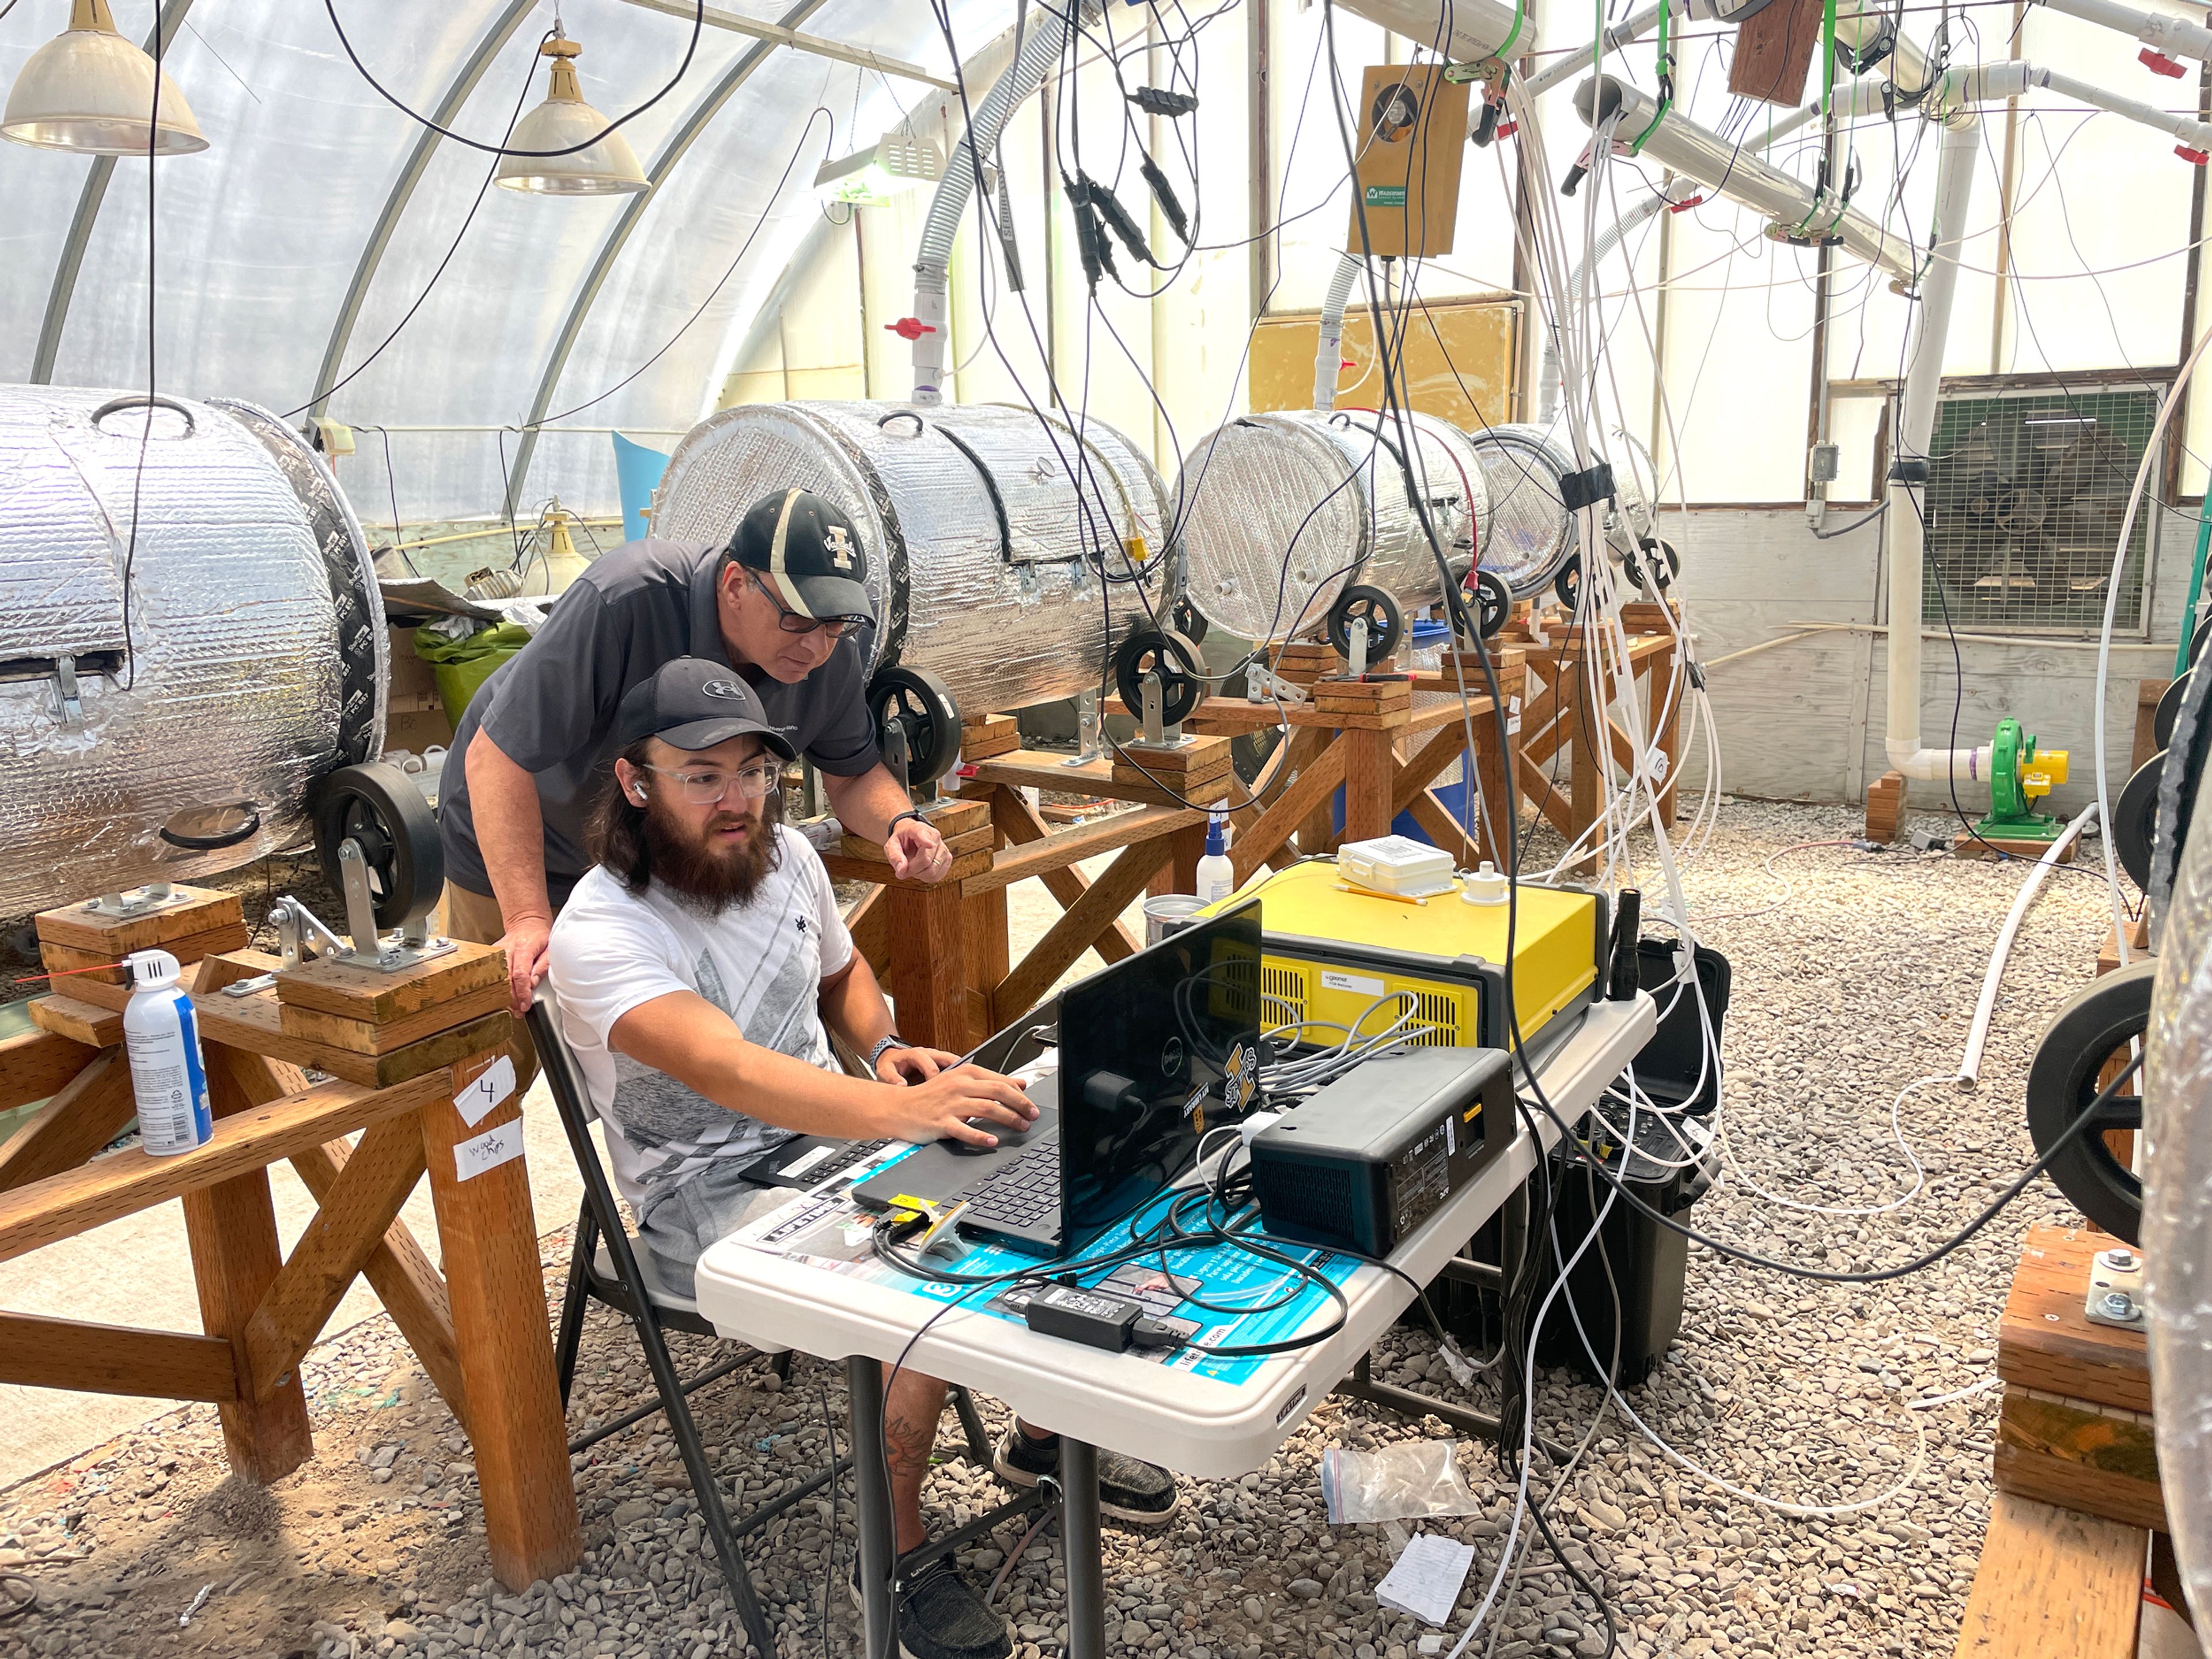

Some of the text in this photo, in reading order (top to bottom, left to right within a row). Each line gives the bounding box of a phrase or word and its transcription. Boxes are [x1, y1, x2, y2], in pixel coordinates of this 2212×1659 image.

[339, 597, 354, 619] PC 857
[359, 640, 368, 650] PC
[351, 692, 369, 714] PC 857
[480, 1080, 495, 1103] 4
[1184, 1094, 1203, 1118] LIBRARY
[770, 1200, 839, 1238] LIFETIME
[1231, 1265, 1256, 1284] Duradera
[1279, 1389, 1304, 1421] LIFETIME
